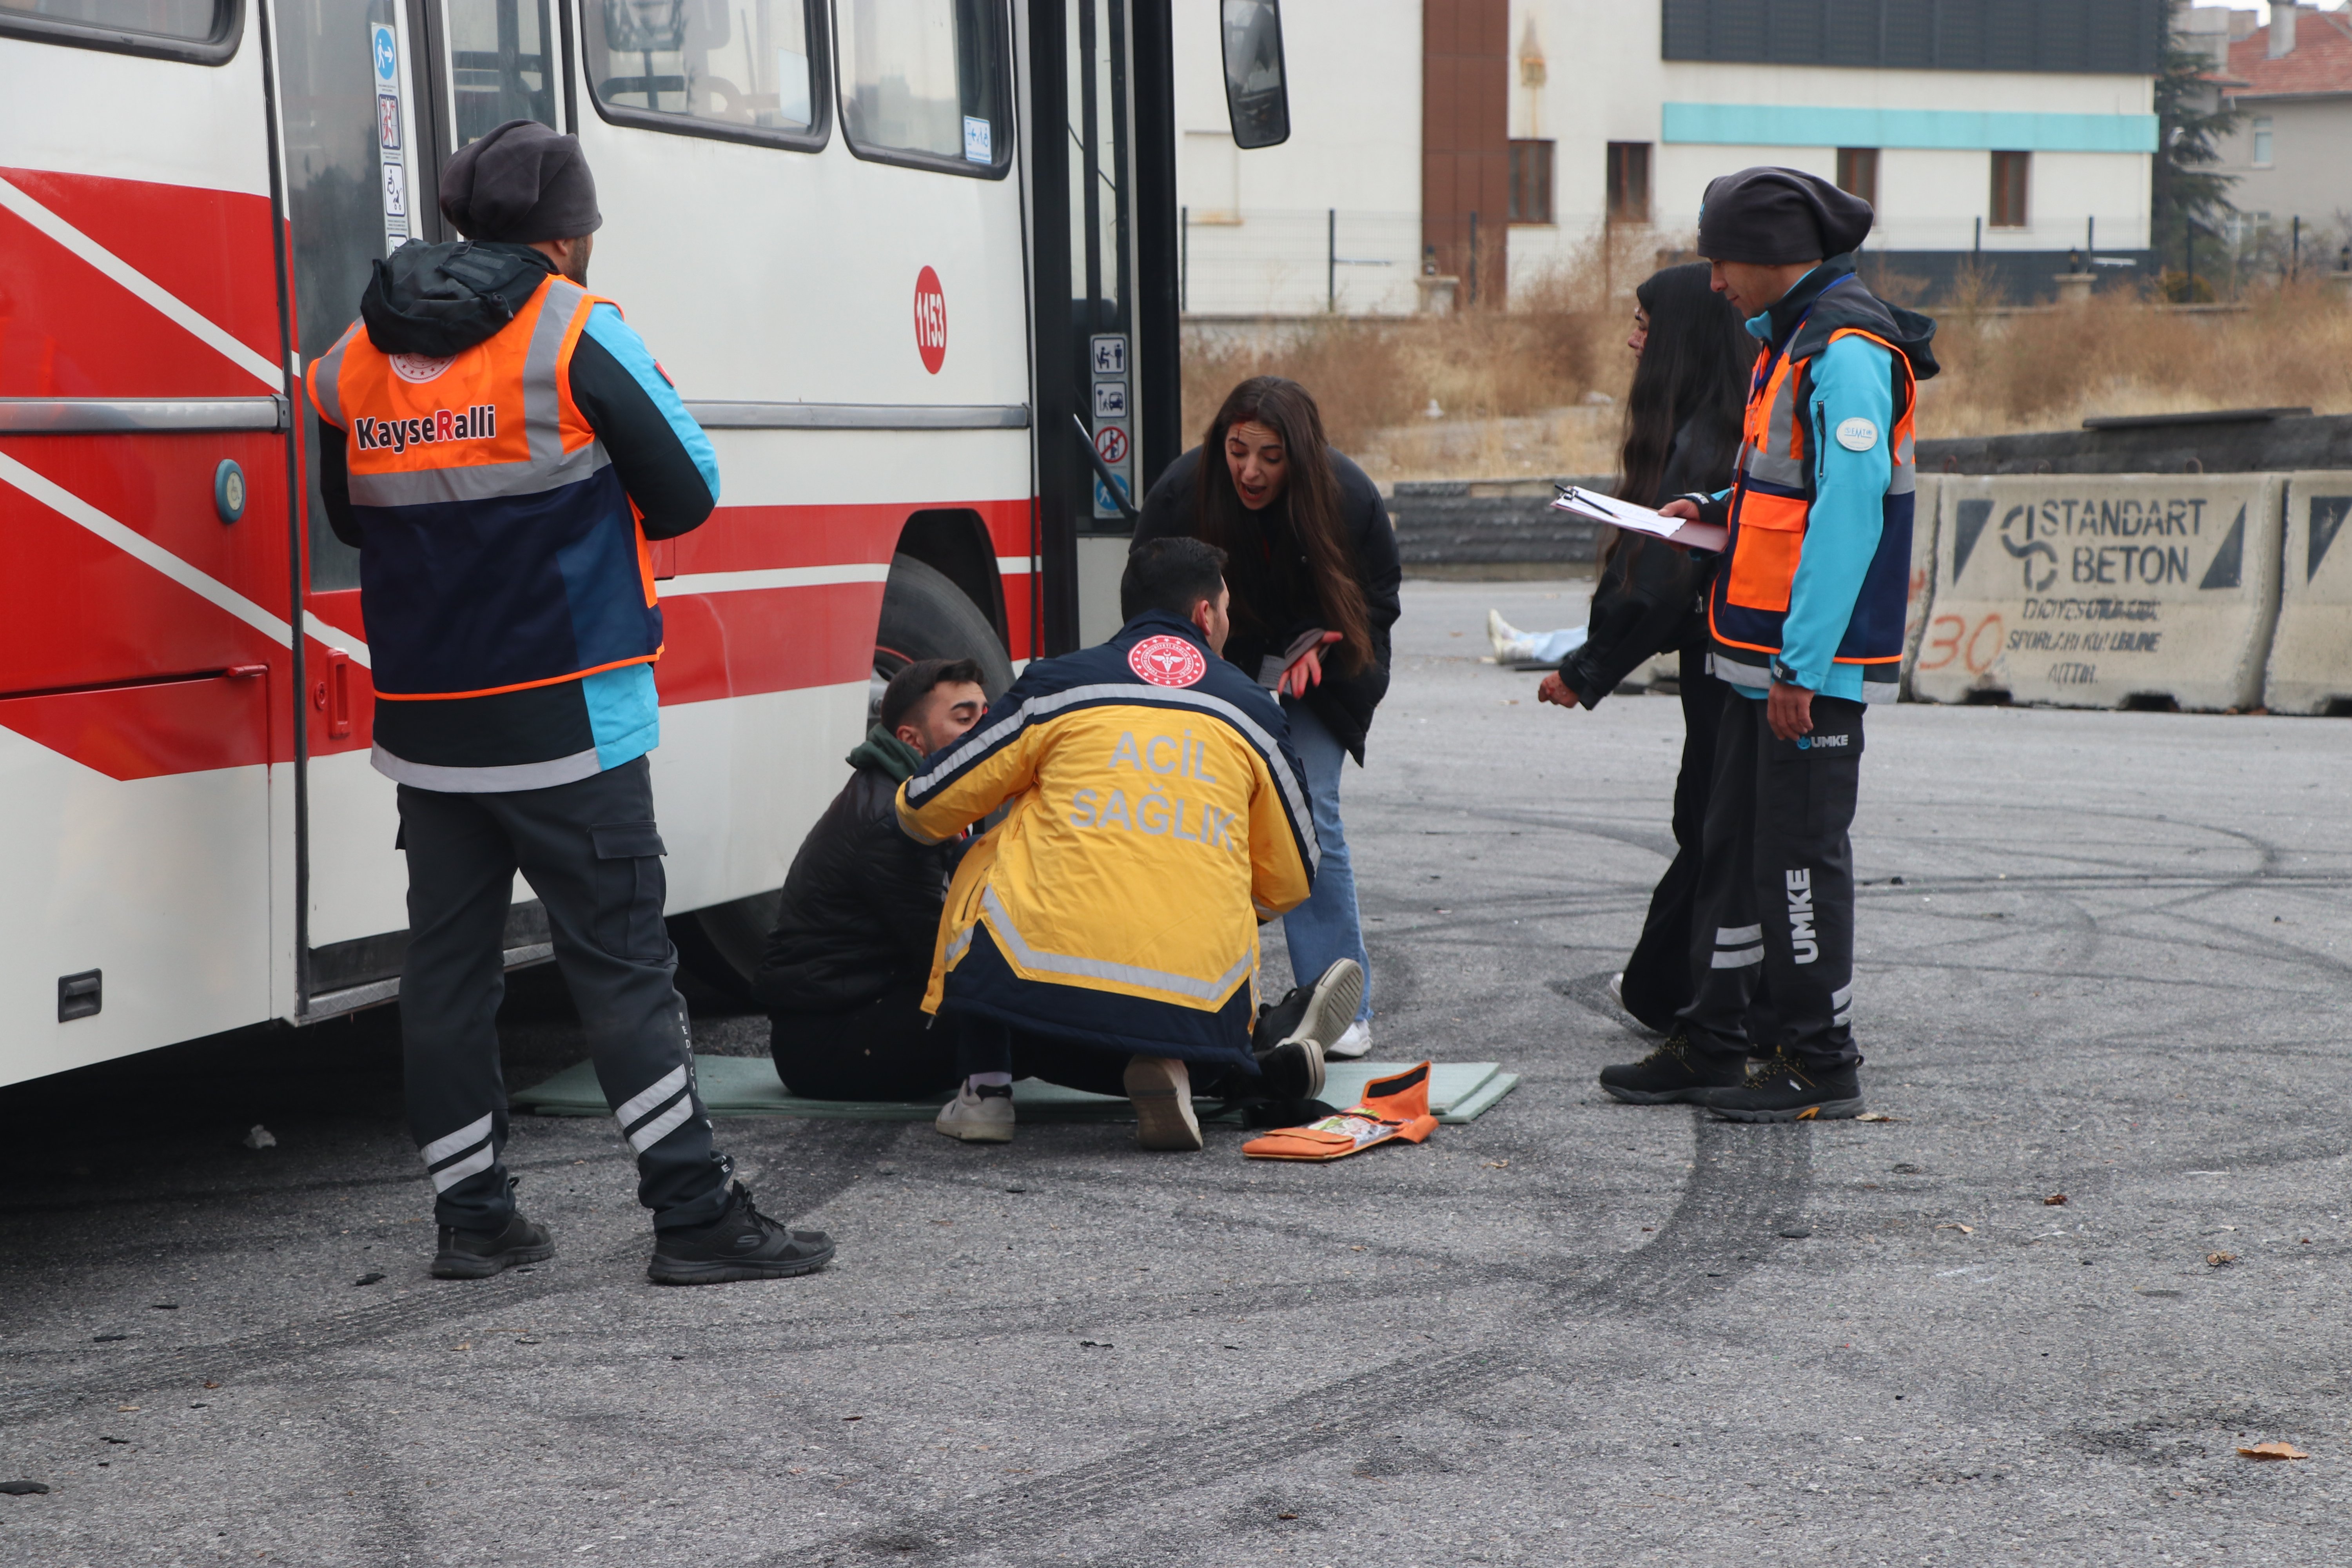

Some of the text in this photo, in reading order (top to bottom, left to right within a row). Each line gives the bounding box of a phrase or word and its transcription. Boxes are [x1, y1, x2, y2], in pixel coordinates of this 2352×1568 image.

[917, 292, 944, 348] 1153
[356, 404, 495, 454] KayseRalli
[2040, 499, 2207, 536] STANDART
[2072, 545, 2189, 584] BETON
[1919, 613, 2004, 675] 30
[1108, 729, 1216, 784] ACİL
[1811, 734, 1848, 748] UMKE
[1069, 782, 1236, 851] SAĞLIK
[1786, 868, 1819, 964] UMKE
[679, 1012, 696, 1090] MEDICA
